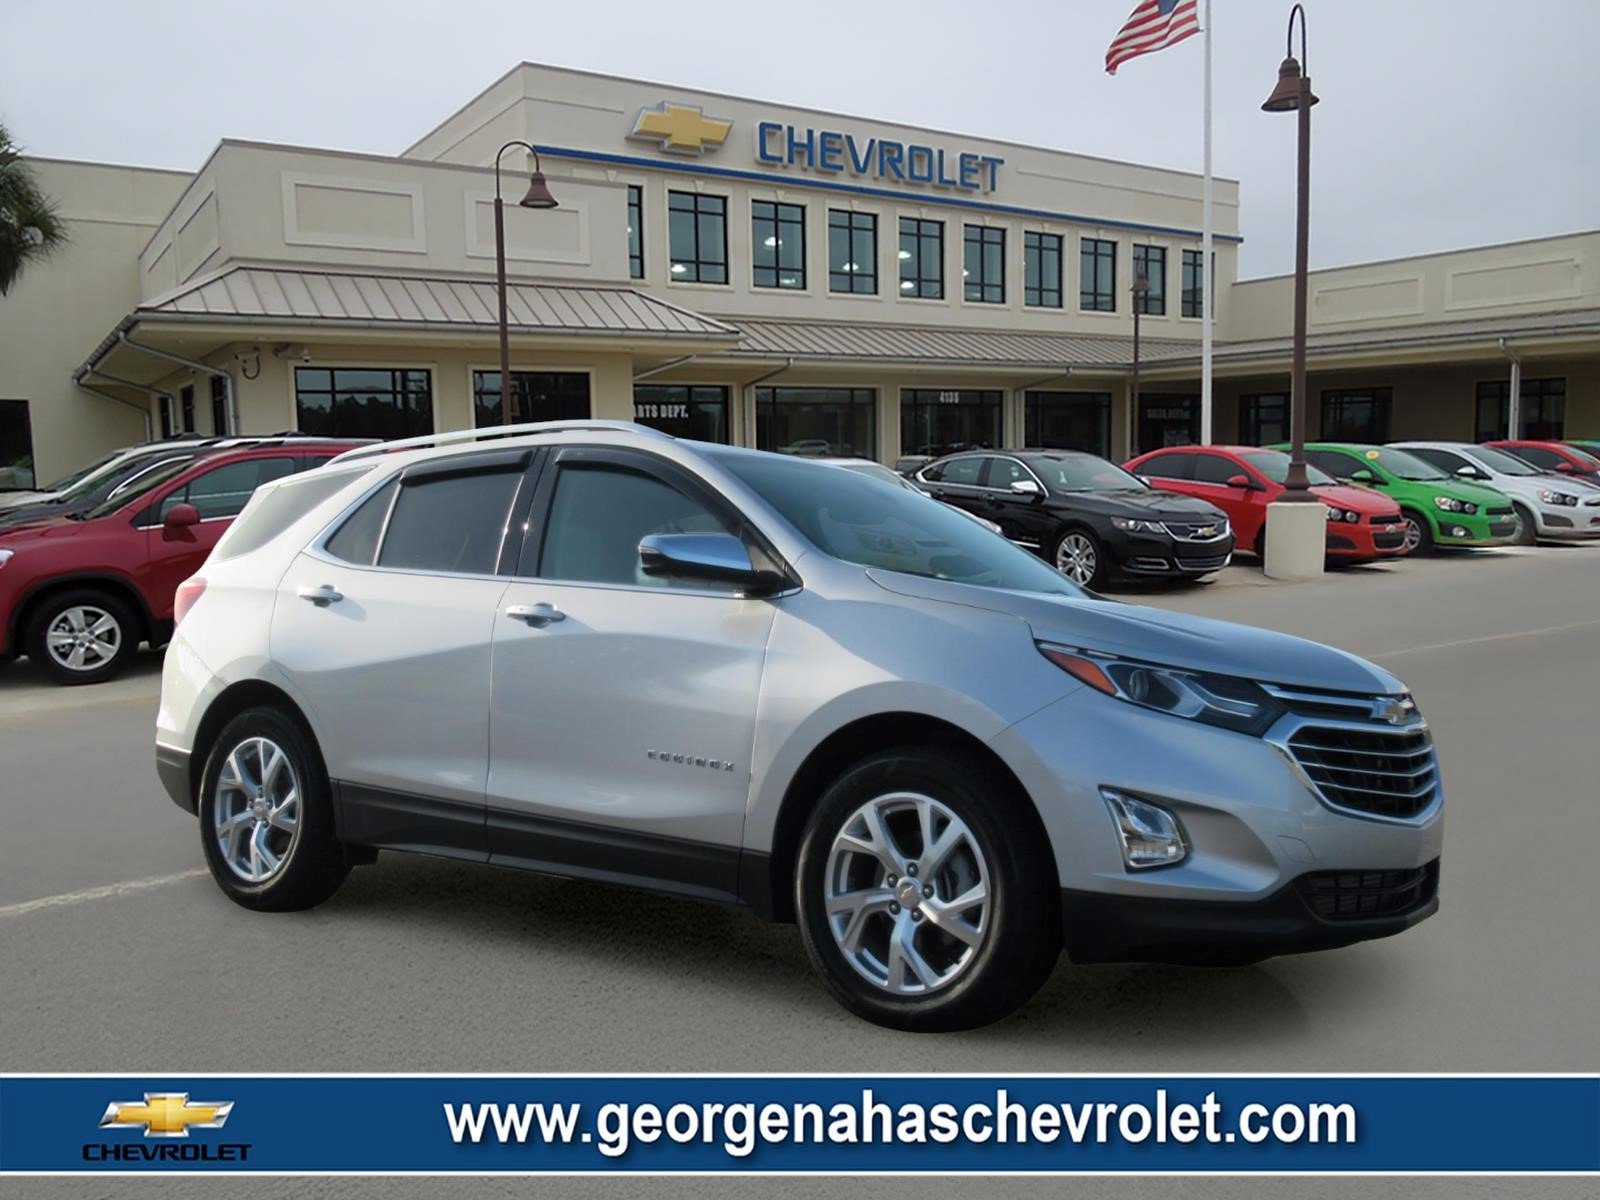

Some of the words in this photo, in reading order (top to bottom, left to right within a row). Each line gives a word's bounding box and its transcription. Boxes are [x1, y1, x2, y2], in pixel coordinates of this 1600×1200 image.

[757, 121, 1005, 192] CHEVROLET
[634, 404, 659, 419] RTS
[660, 404, 689, 419] DEPT.
[647, 748, 735, 772] EQUINOX
